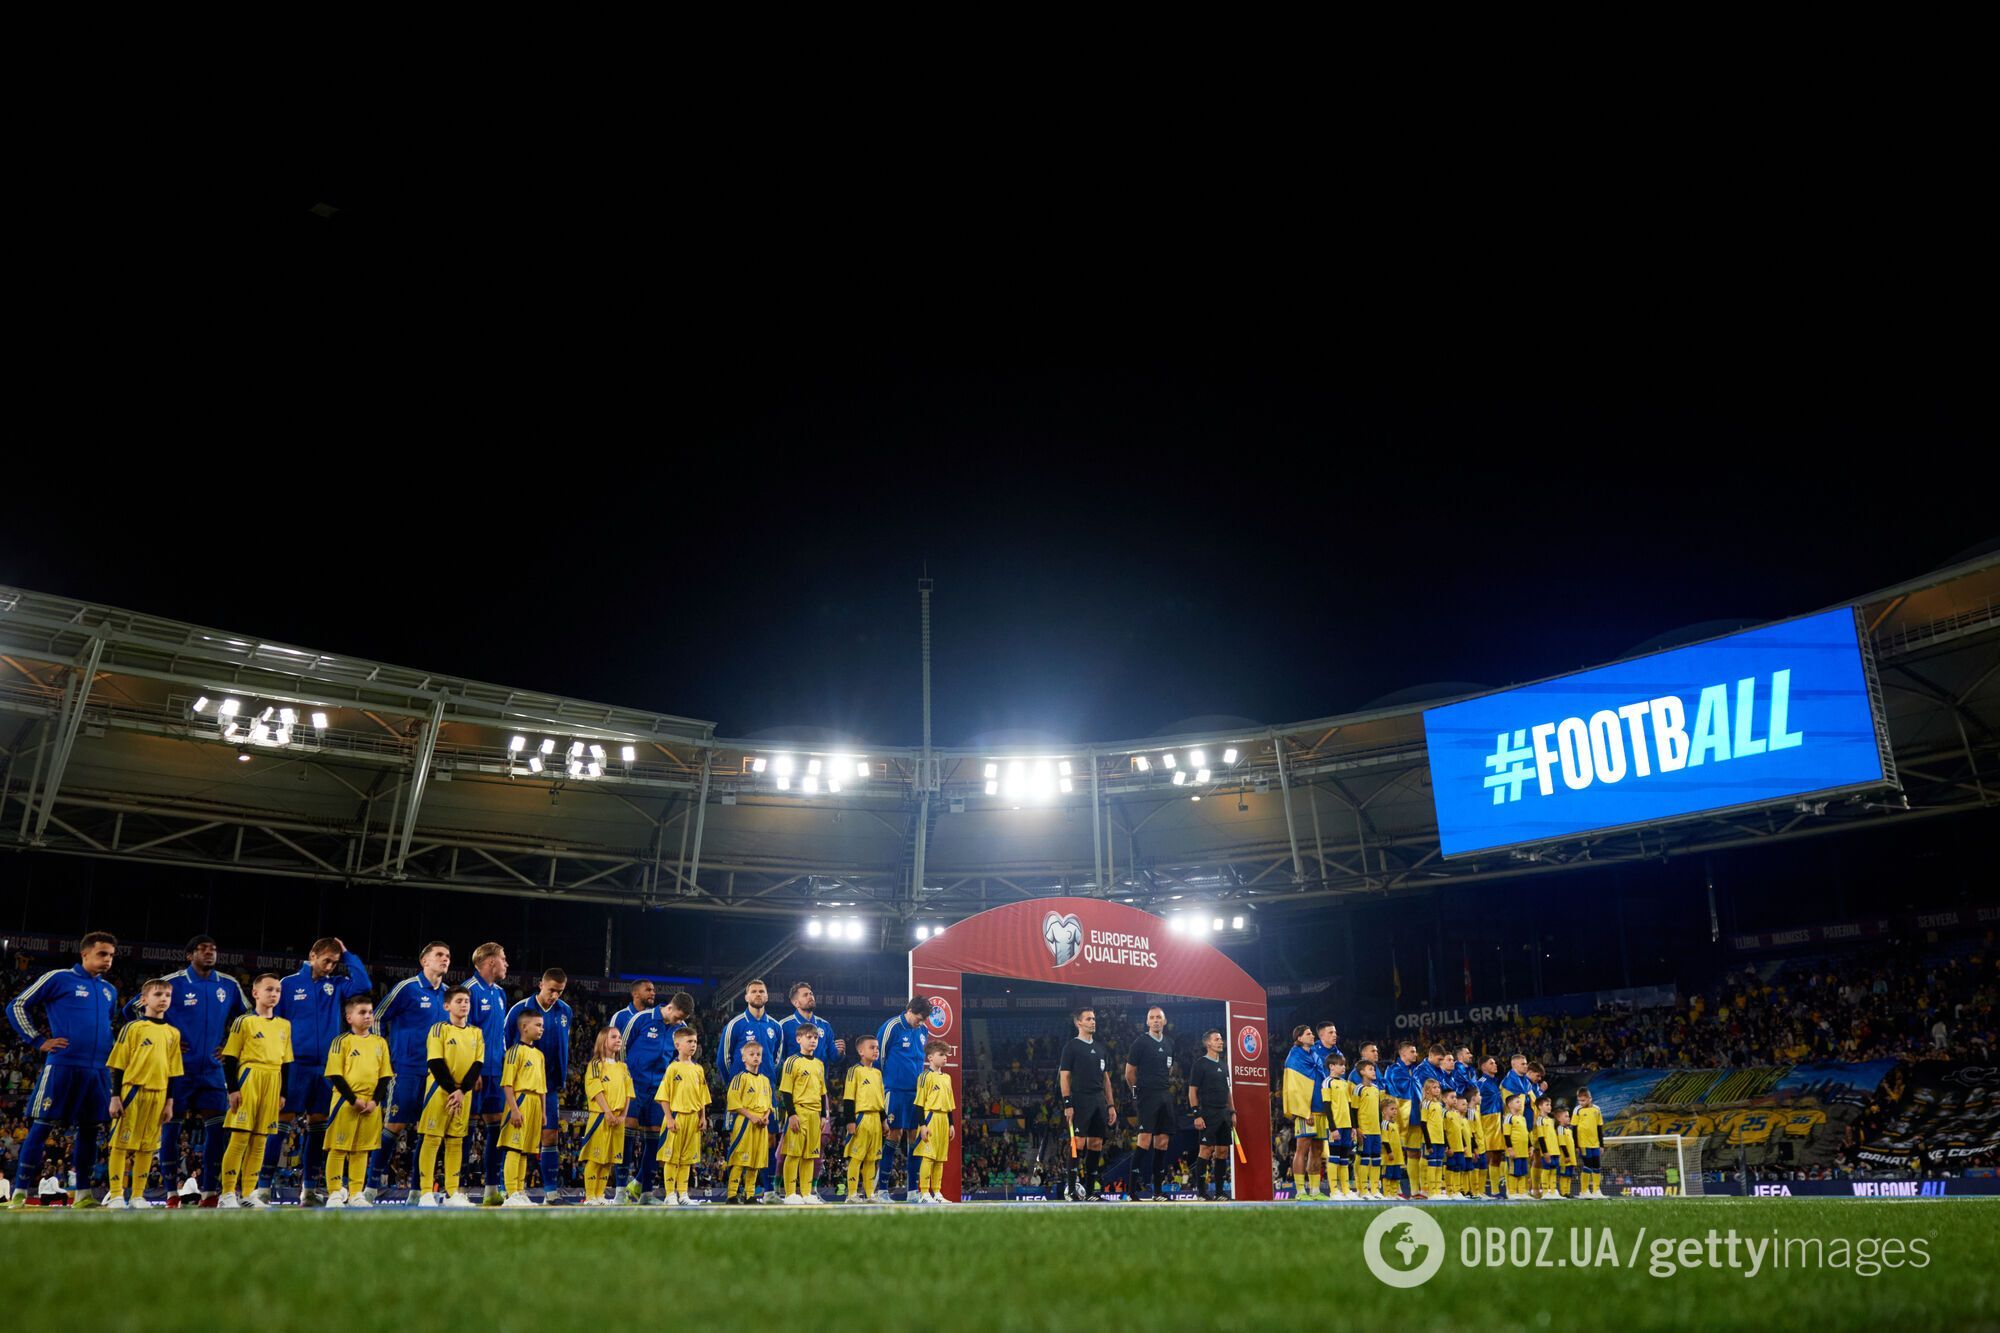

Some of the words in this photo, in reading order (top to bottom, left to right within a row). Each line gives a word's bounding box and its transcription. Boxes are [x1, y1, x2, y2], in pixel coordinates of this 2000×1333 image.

[1484, 669, 1802, 805] #FOOTBALL
[1091, 930, 1150, 950] EUROPEAN
[1084, 944, 1158, 969] QUALIFIERS
[1394, 1009, 1464, 1029] ORGULL
[1234, 1065, 1268, 1078] RESPECT
[1741, 1116, 1768, 1131] 25
[1852, 1181, 1919, 1197] WELCOME
[1920, 1180, 1947, 1197] ALL
